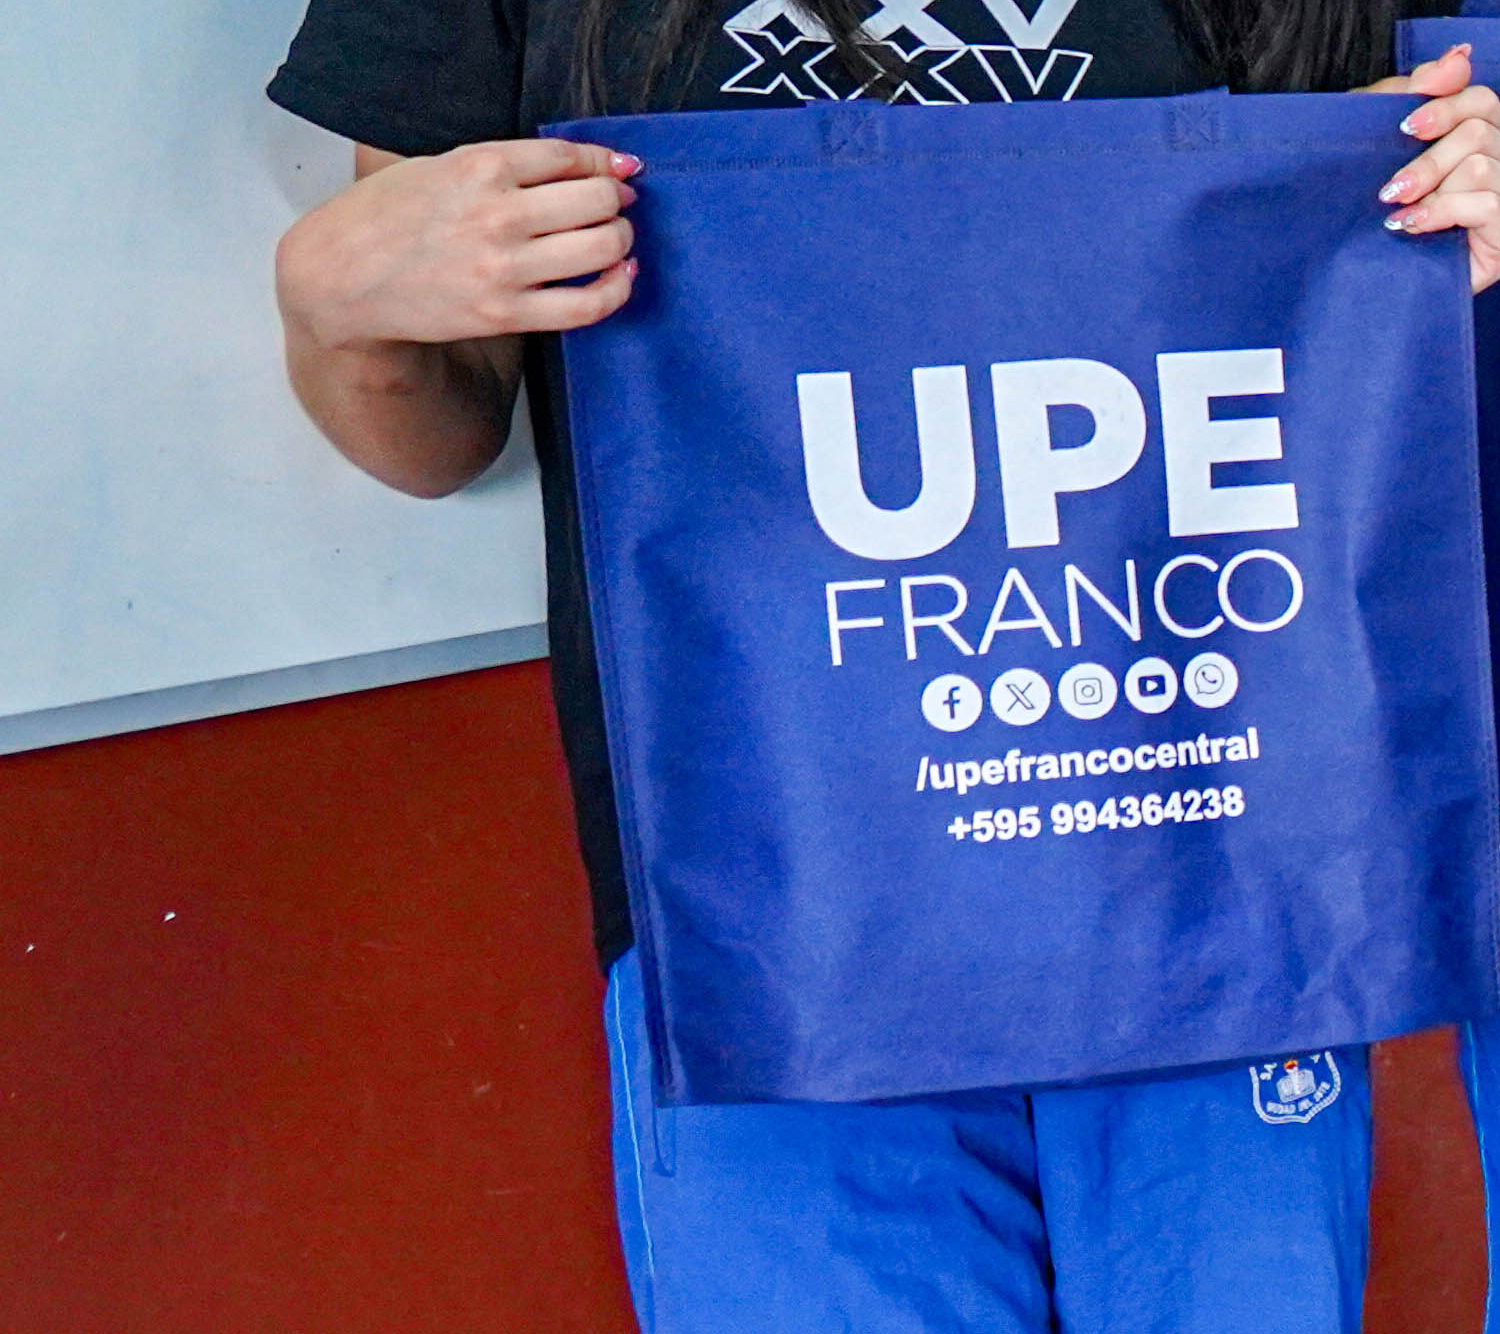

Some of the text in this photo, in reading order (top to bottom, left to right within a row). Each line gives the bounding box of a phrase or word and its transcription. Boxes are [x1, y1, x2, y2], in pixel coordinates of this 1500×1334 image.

[796, 347, 1300, 561] UPE
[825, 549, 1304, 666] FRANCO
[916, 727, 1260, 794] /upefrancocentral
[947, 786, 1246, 843] +595 994364238
